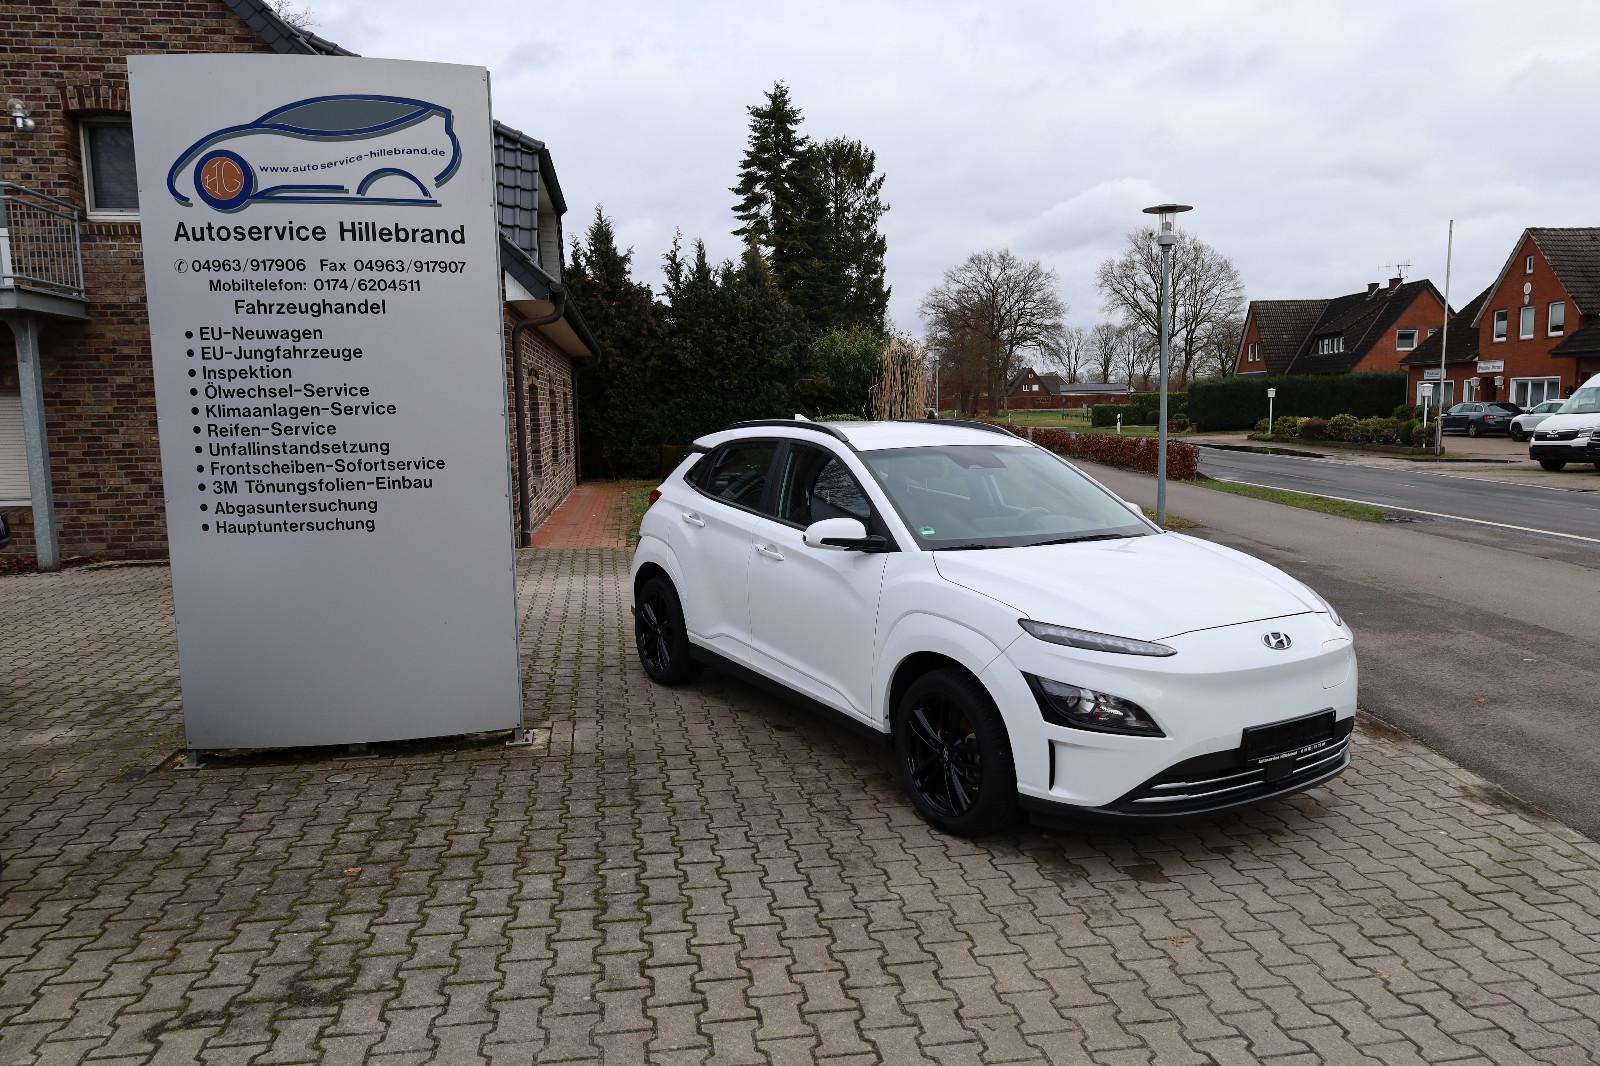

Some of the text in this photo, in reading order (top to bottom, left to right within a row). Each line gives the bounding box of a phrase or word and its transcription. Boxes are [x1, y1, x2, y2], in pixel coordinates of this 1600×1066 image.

[259, 147, 446, 173] www.autoservice-hillebrand.de
[174, 221, 466, 245] Autoservice Hillebrand
[191, 257, 467, 274] 04963/917906 Fax 04963/917907
[209, 278, 421, 293] Mobiltelefon: 0174/6204511
[235, 299, 387, 318] Fahrzeughandel
[199, 326, 323, 343] EU-Neuwagen
[201, 345, 364, 362] EU-Jungfahrzeuge
[202, 364, 293, 383] Inspektion
[204, 382, 370, 400] Ölwechsel-Service
[205, 402, 397, 420] Klimaanlagen-Service
[207, 421, 337, 438] Reifen-Service
[208, 440, 390, 457] Unfallinstandsetzung
[210, 457, 446, 476] Frontscheiben-Sofortservice
[212, 476, 433, 496] 3M Tönungsfolien-Einbau
[214, 498, 379, 518] Abgasuntersuchung
[215, 518, 376, 535] Hauptuntersuchung
